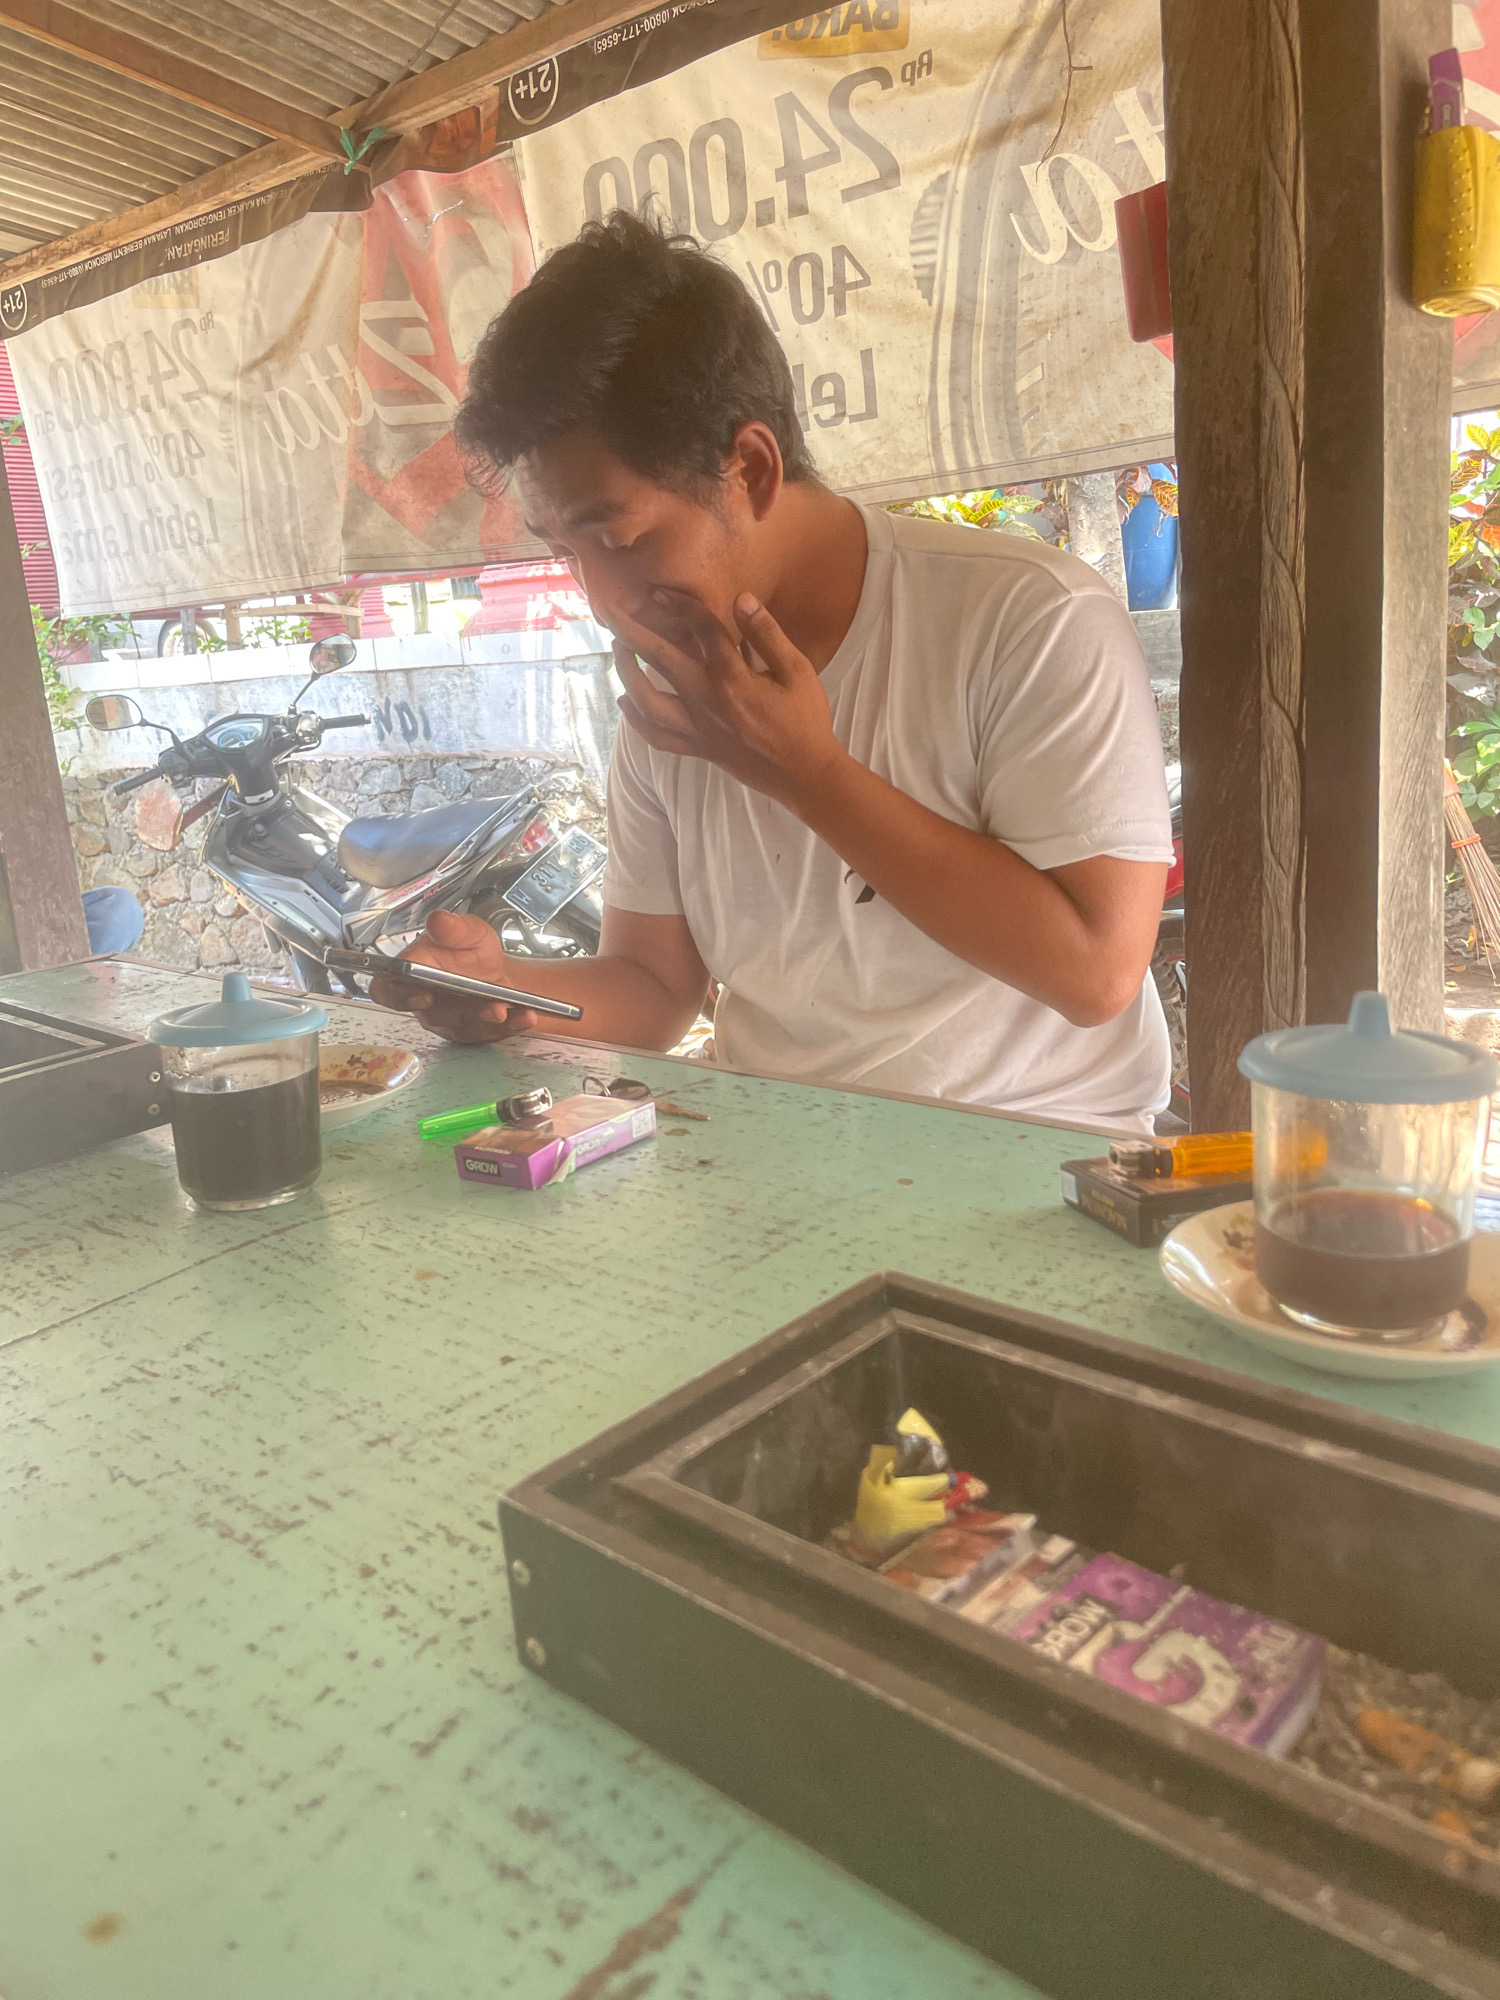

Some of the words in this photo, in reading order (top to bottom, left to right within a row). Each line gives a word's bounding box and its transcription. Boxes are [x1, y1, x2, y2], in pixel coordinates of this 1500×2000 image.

[515, 63, 552, 99] 21+
[3, 290, 23, 313] 21+
[465, 1158, 499, 1175] GROW
